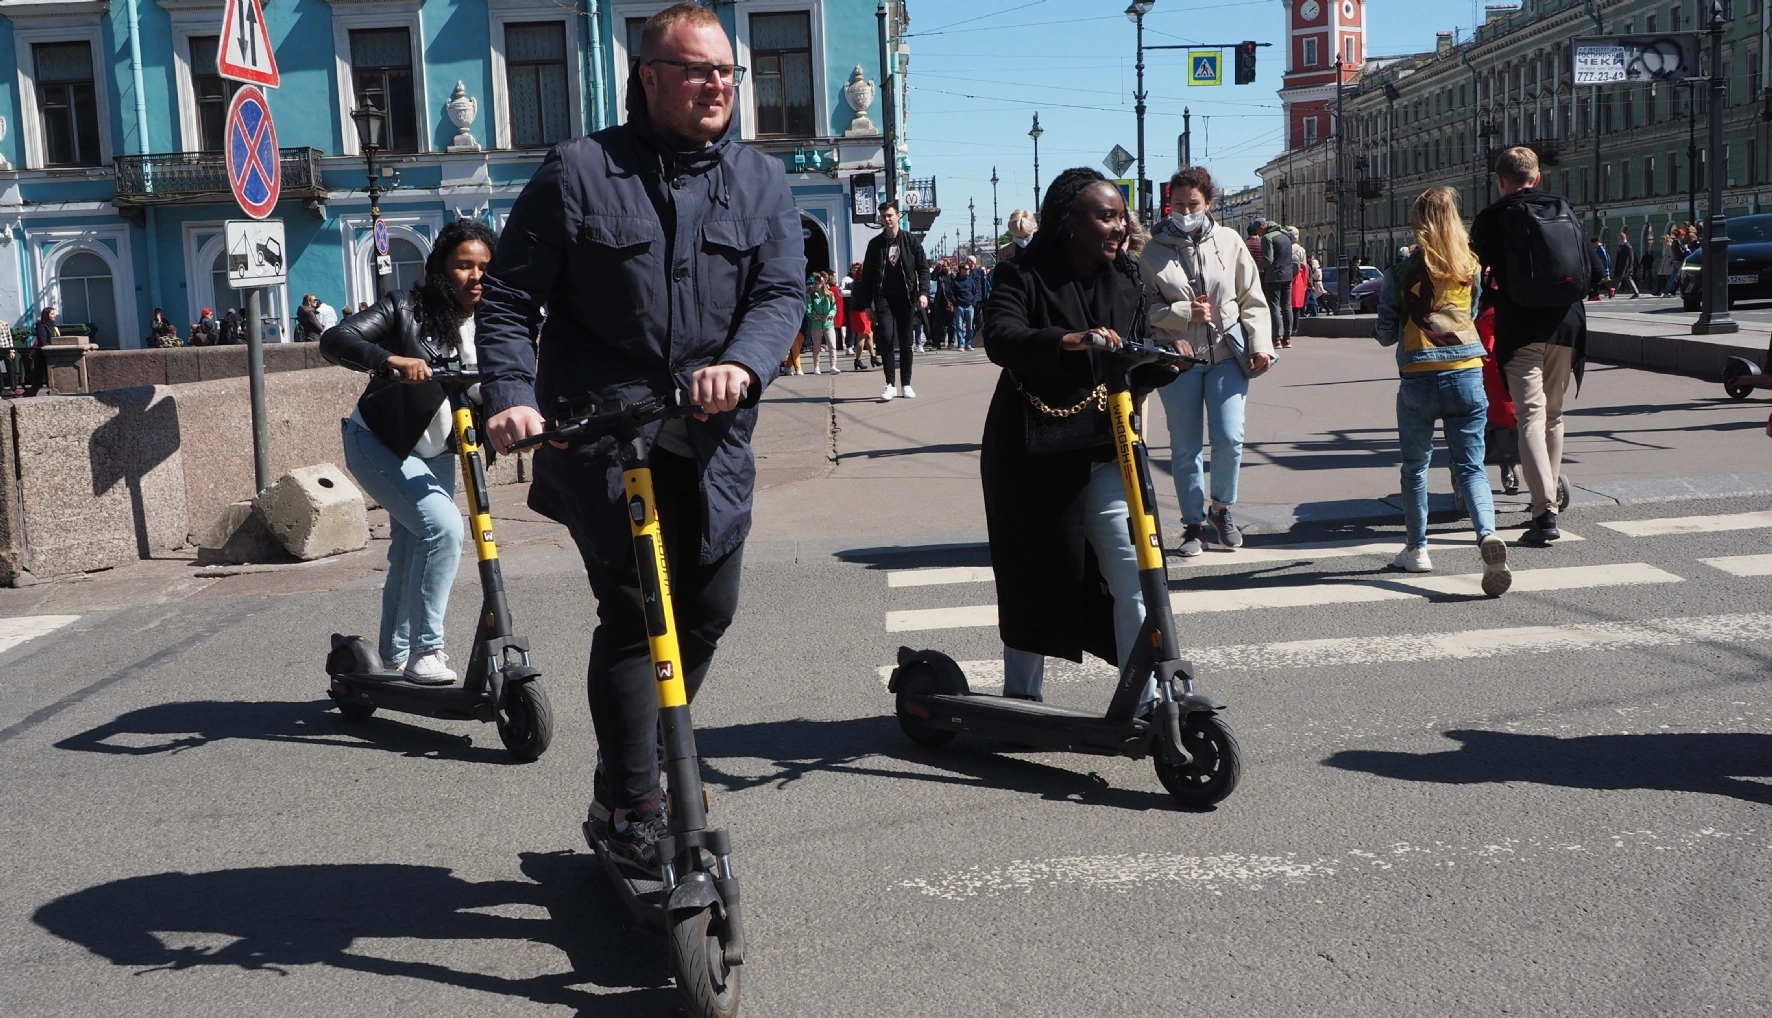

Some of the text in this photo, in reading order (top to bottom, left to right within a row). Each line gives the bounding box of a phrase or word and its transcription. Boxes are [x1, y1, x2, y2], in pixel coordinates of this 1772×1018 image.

[1578, 58, 1624, 66] ЧЕКИ
[1113, 404, 1131, 464] WHOOSH
[657, 663, 671, 678] W
